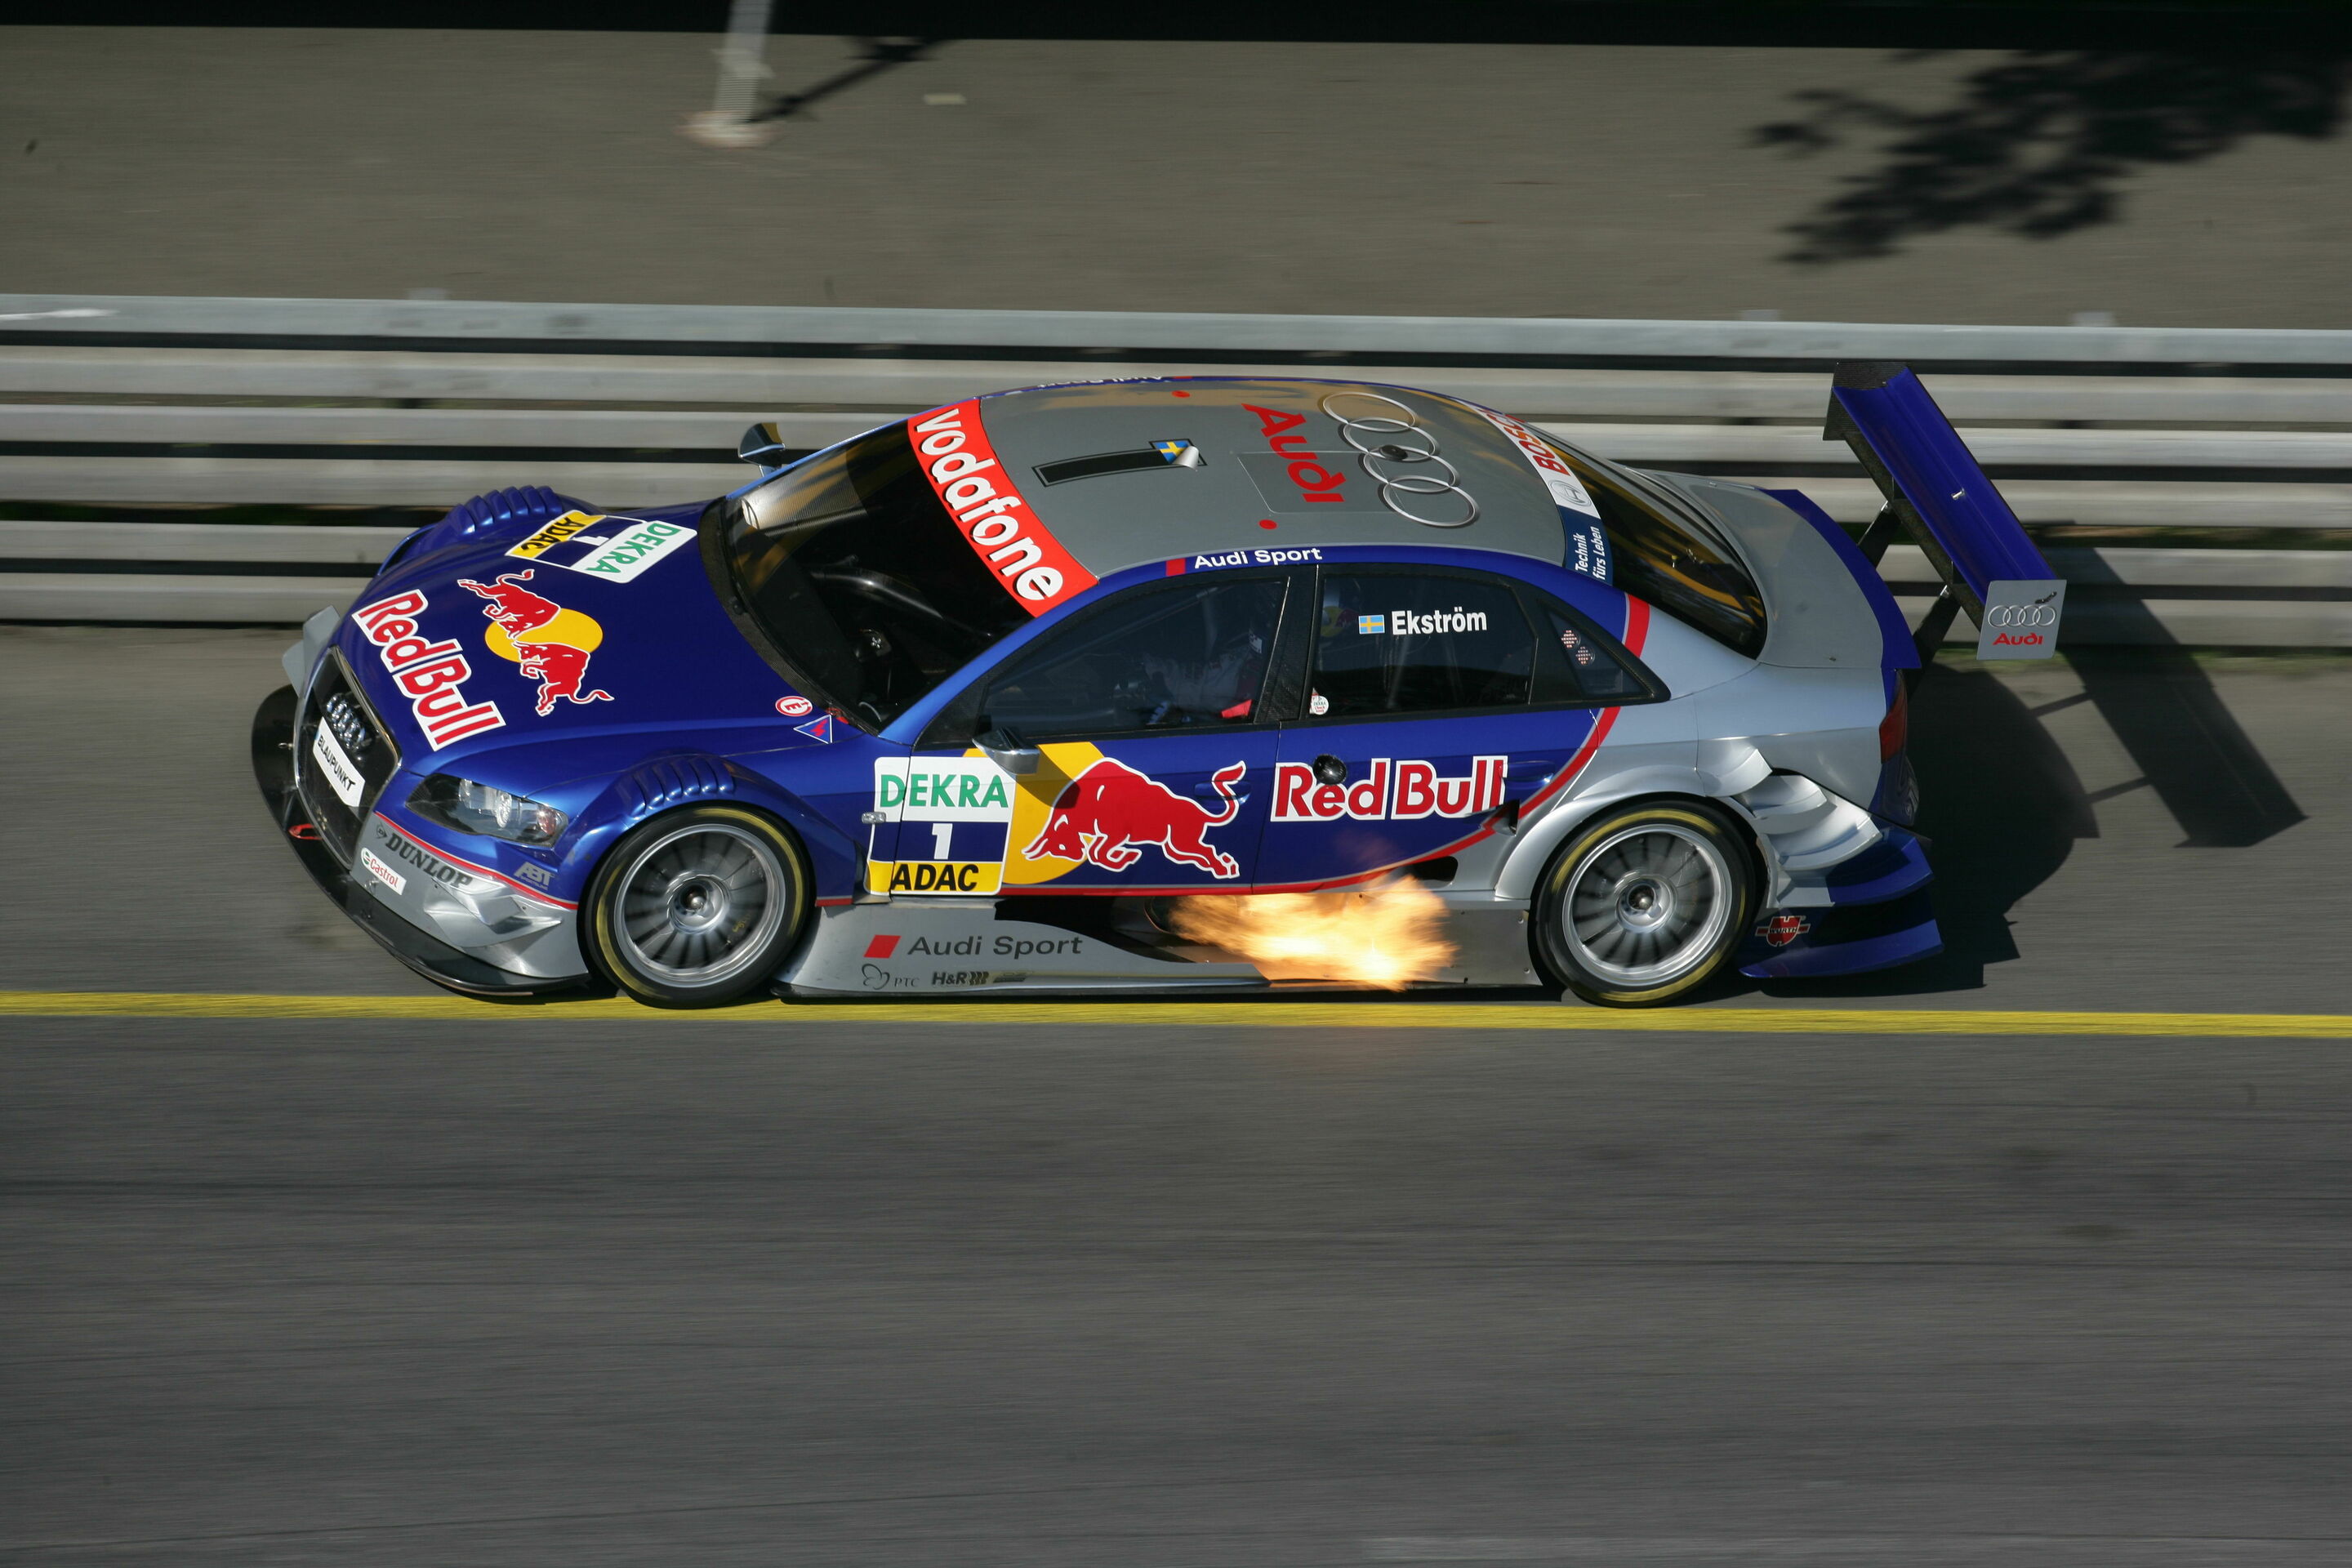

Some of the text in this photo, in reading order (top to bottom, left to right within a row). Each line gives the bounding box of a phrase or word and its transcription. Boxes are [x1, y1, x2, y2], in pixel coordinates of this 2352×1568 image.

[1241, 403, 1348, 503] Audi
[915, 408, 1063, 601] vodafone
[520, 516, 586, 551] ADAC
[586, 523, 682, 573] DEKRA
[1194, 547, 1323, 569] Audi Sport
[1575, 532, 1588, 572] Technik
[1589, 526, 1606, 581] fürs Leben
[1391, 607, 1487, 635] Ekström
[1992, 631, 2044, 646] Audi
[354, 590, 505, 749] Red Bull
[318, 734, 357, 791] BLAUPUNKT
[880, 773, 1009, 808] DEKRA
[1272, 756, 1508, 821] Red Bull
[931, 822, 954, 860] 1
[370, 858, 399, 889] Castrol
[385, 832, 474, 889] DUNLOP
[514, 862, 557, 886] ABT
[890, 863, 980, 892] ADAC
[906, 935, 1084, 960] Audi Sport
[893, 977, 920, 987] PTC
